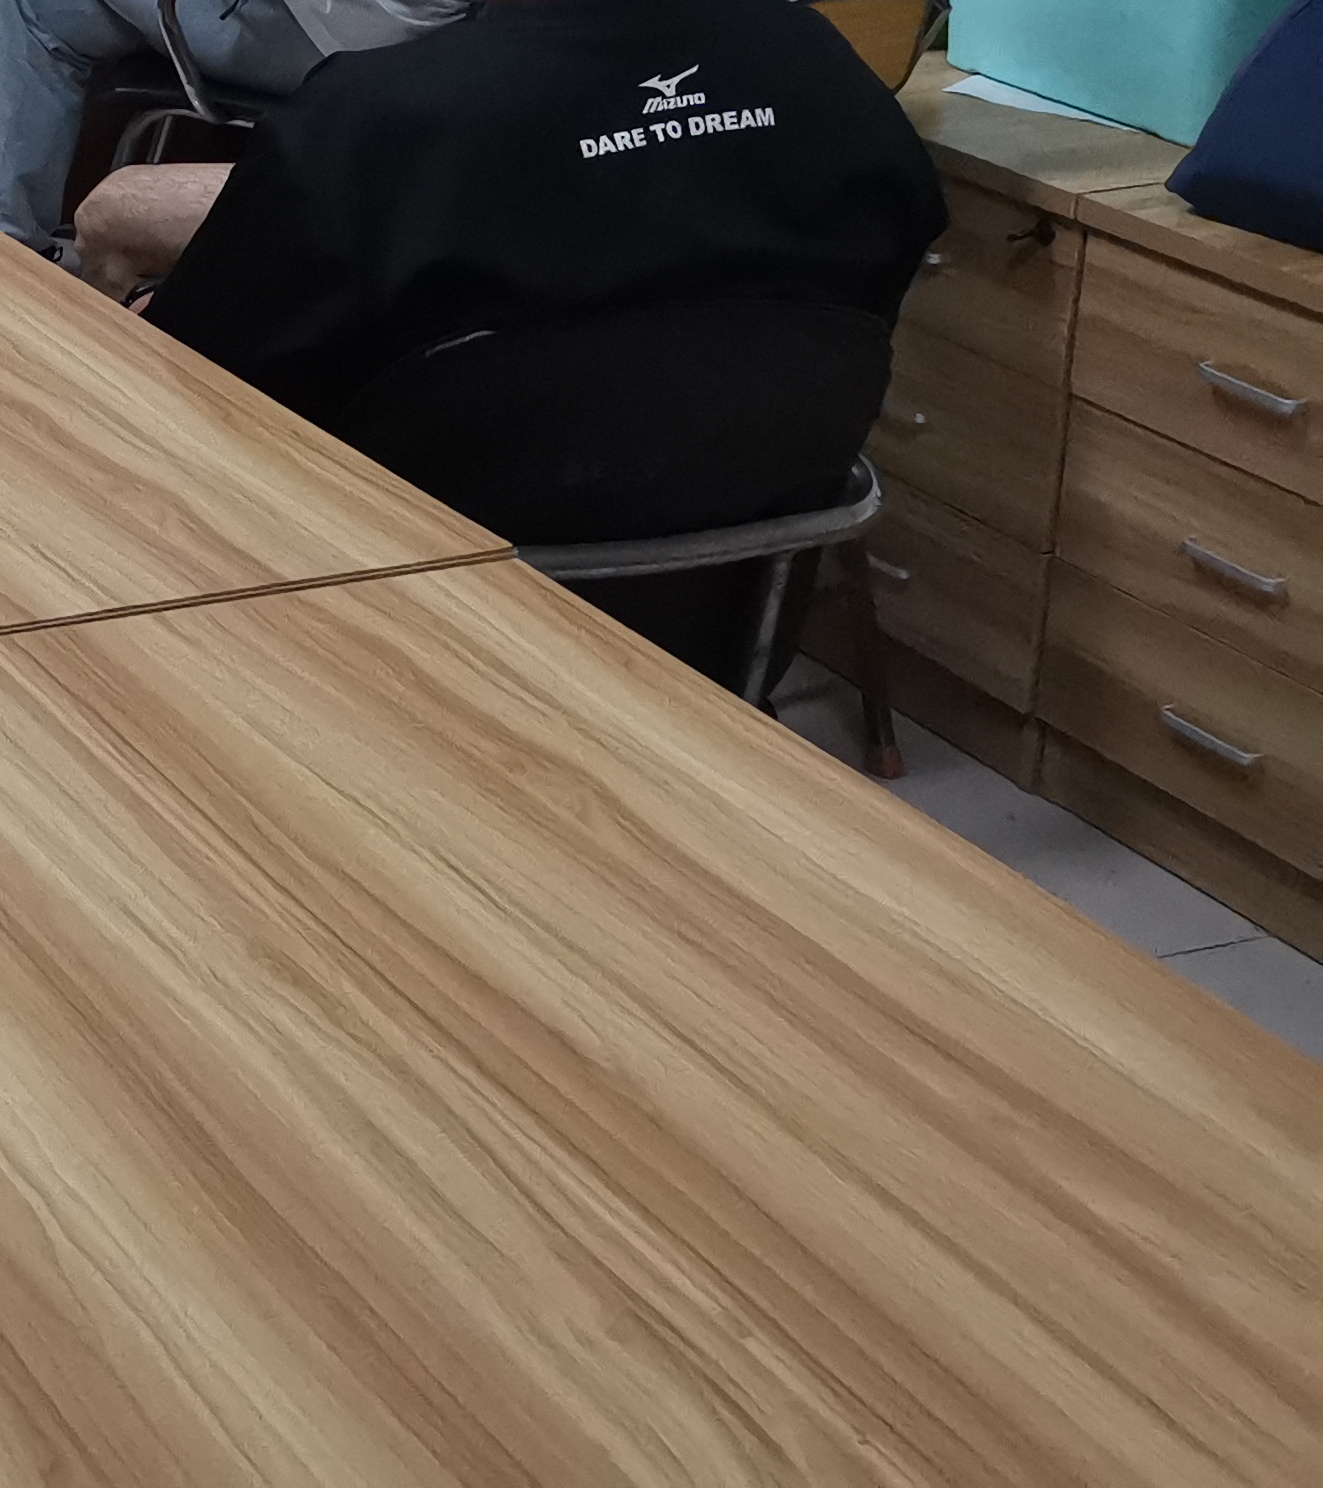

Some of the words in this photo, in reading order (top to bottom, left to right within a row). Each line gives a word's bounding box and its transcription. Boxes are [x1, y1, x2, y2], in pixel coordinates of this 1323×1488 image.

[580, 127, 647, 159] DARE
[650, 120, 682, 143] TO
[688, 107, 776, 137] DREAM
